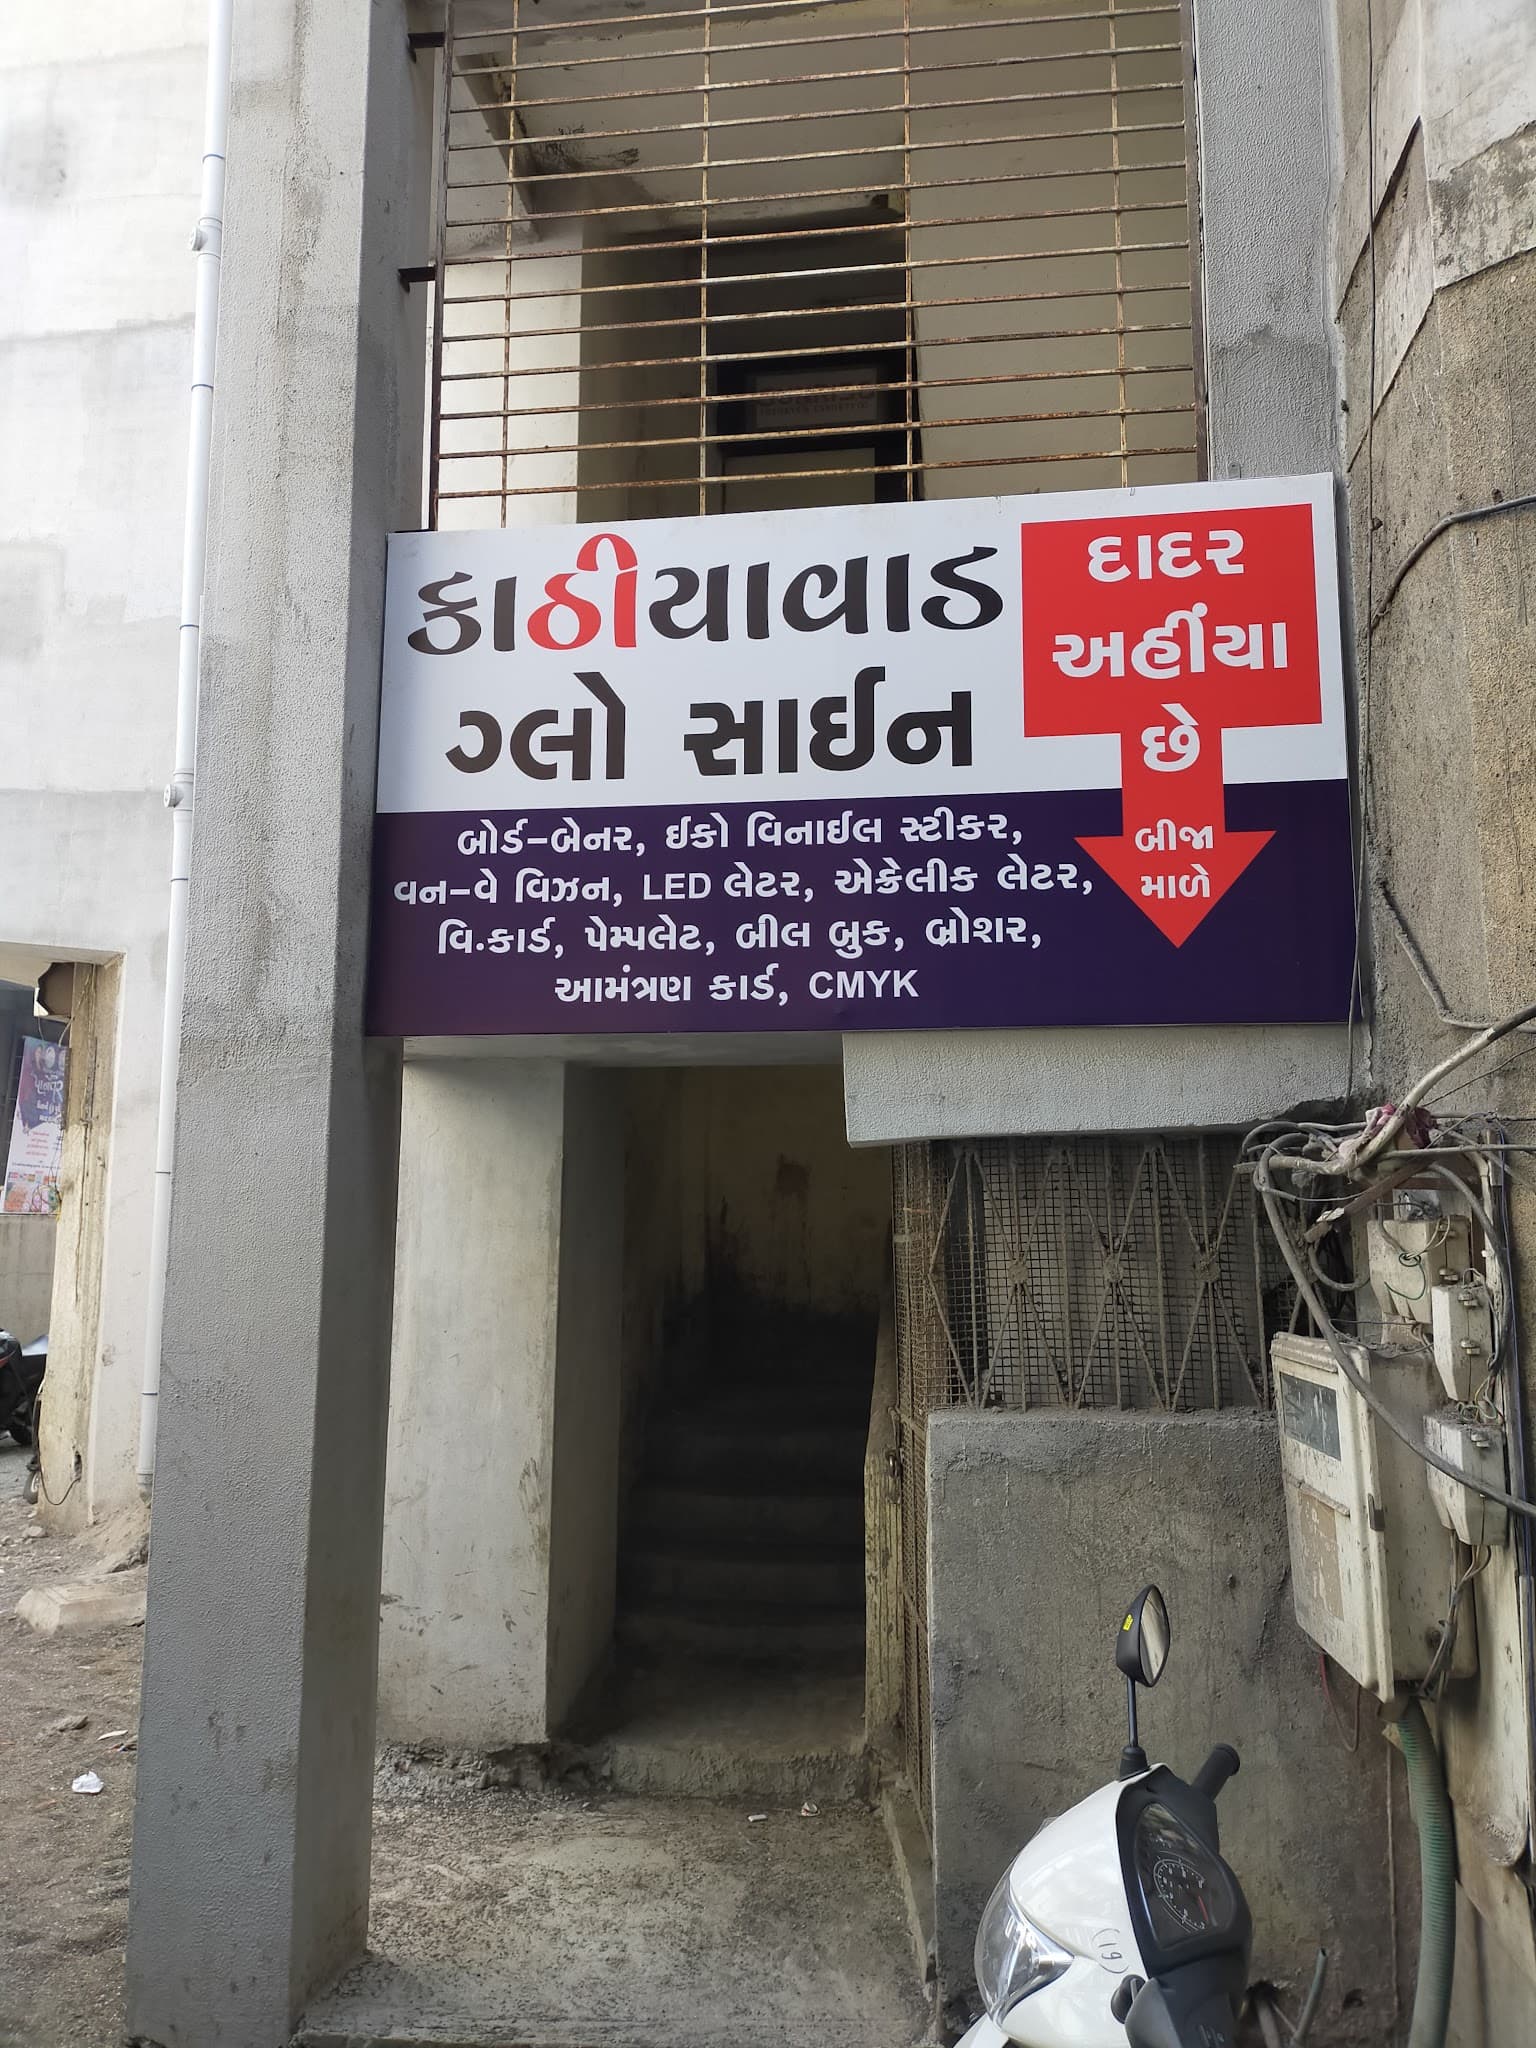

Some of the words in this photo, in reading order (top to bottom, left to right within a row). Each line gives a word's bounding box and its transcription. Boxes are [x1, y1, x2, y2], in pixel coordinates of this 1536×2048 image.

[1087, 529, 1245, 583] દાદર
[407, 532, 1005, 656] કાઠીયાવાડ
[1052, 602, 1289, 680] અહીંયા
[444, 670, 627, 781] ગ્લો
[683, 665, 974, 777] સાઈન
[1140, 702, 1201, 774] છે
[665, 812, 729, 850] ઈકો
[746, 810, 883, 848] વિનાઈલ
[899, 806, 1023, 846] સ્ટીકર,
[1134, 818, 1214, 853] બીજા
[393, 867, 498, 906] વન-વે
[514, 867, 624, 909] વિઝન,
[643, 871, 713, 901] LED
[723, 861, 815, 904] લેટર,
[833, 856, 979, 896] એક્રેલીક
[996, 853, 1094, 896] લેટર,
[1140, 863, 1212, 899] માળે
[437, 916, 565, 960] વિ.કાર્ડ,
[584, 914, 716, 957] પેમ્પલેટ,
[735, 913, 811, 950] બીલ
[828, 919, 905, 961] બુક,
[925, 906, 1042, 950] બ્રોશર,
[554, 963, 692, 1004] આમંત્રણ
[708, 962, 789, 1008] કાર્ડ,
[808, 968, 920, 1000] CMYK
